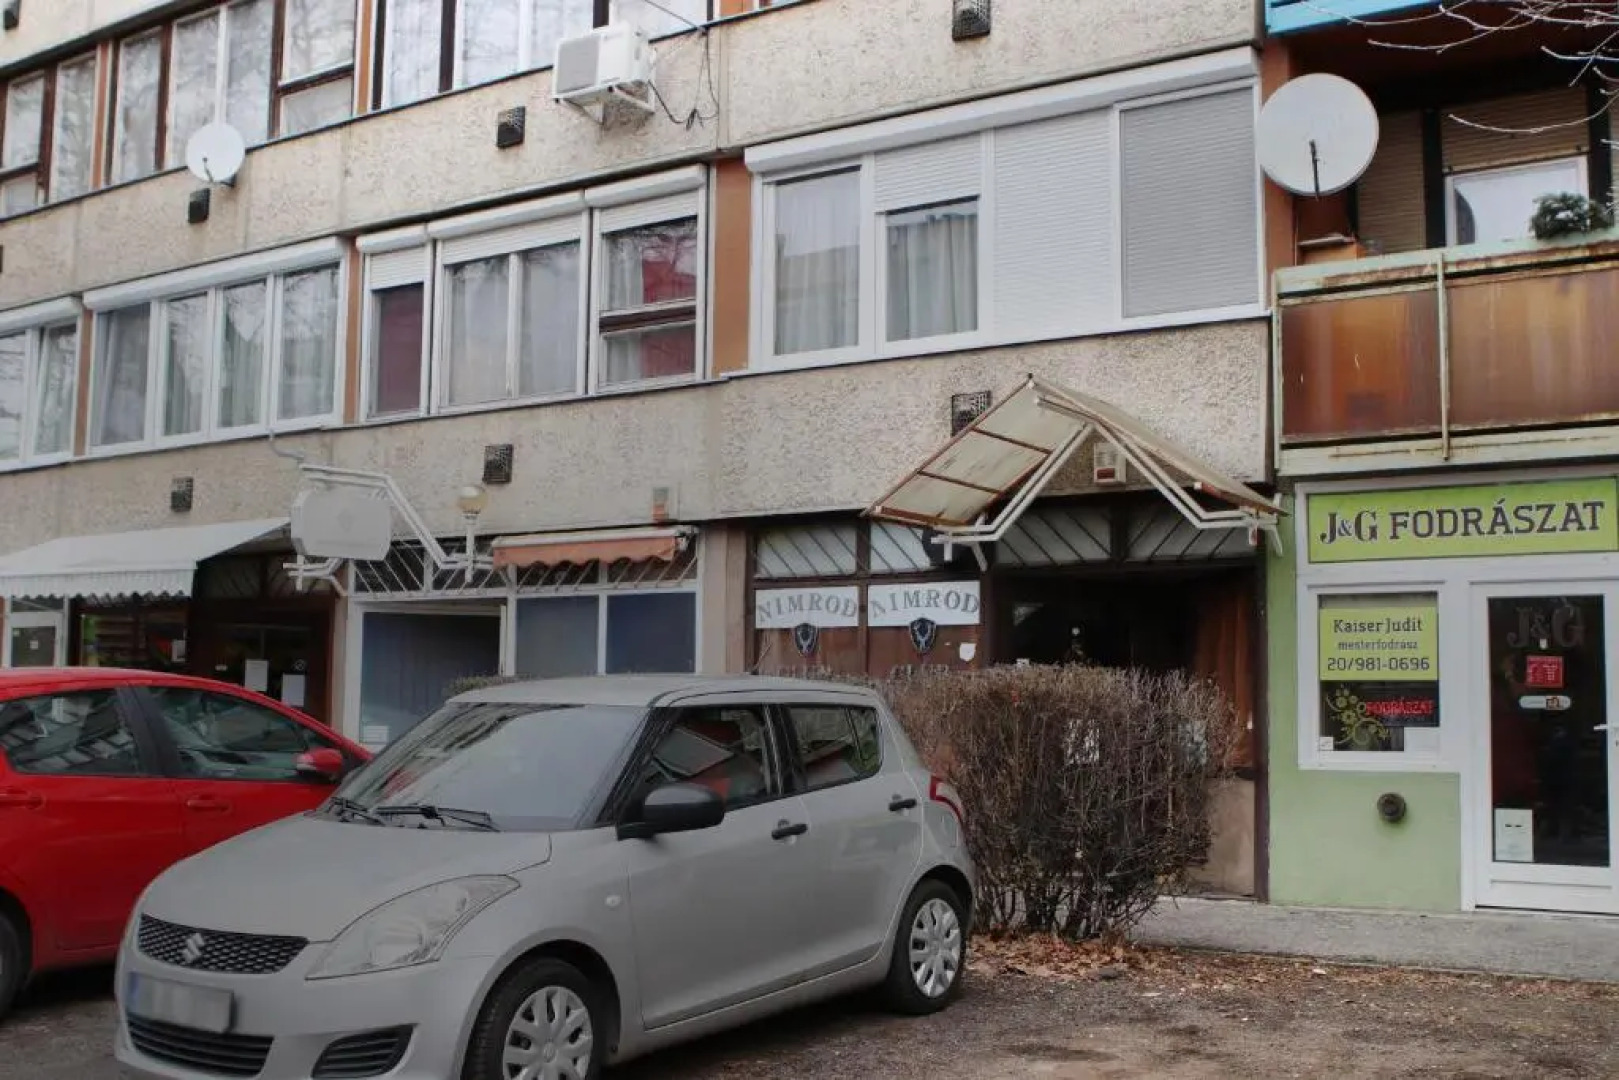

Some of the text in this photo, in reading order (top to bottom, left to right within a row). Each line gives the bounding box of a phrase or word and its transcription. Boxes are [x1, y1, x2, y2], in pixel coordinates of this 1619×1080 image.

[1320, 498, 1604, 544] J&G FODRÁSZAT
[757, 592, 858, 621] NIMROD
[872, 589, 978, 617] NIMROD
[1333, 617, 1422, 634] Kaiser Judit
[1507, 606, 1585, 648] J&G
[1327, 657, 1430, 671] 20/981-0696
